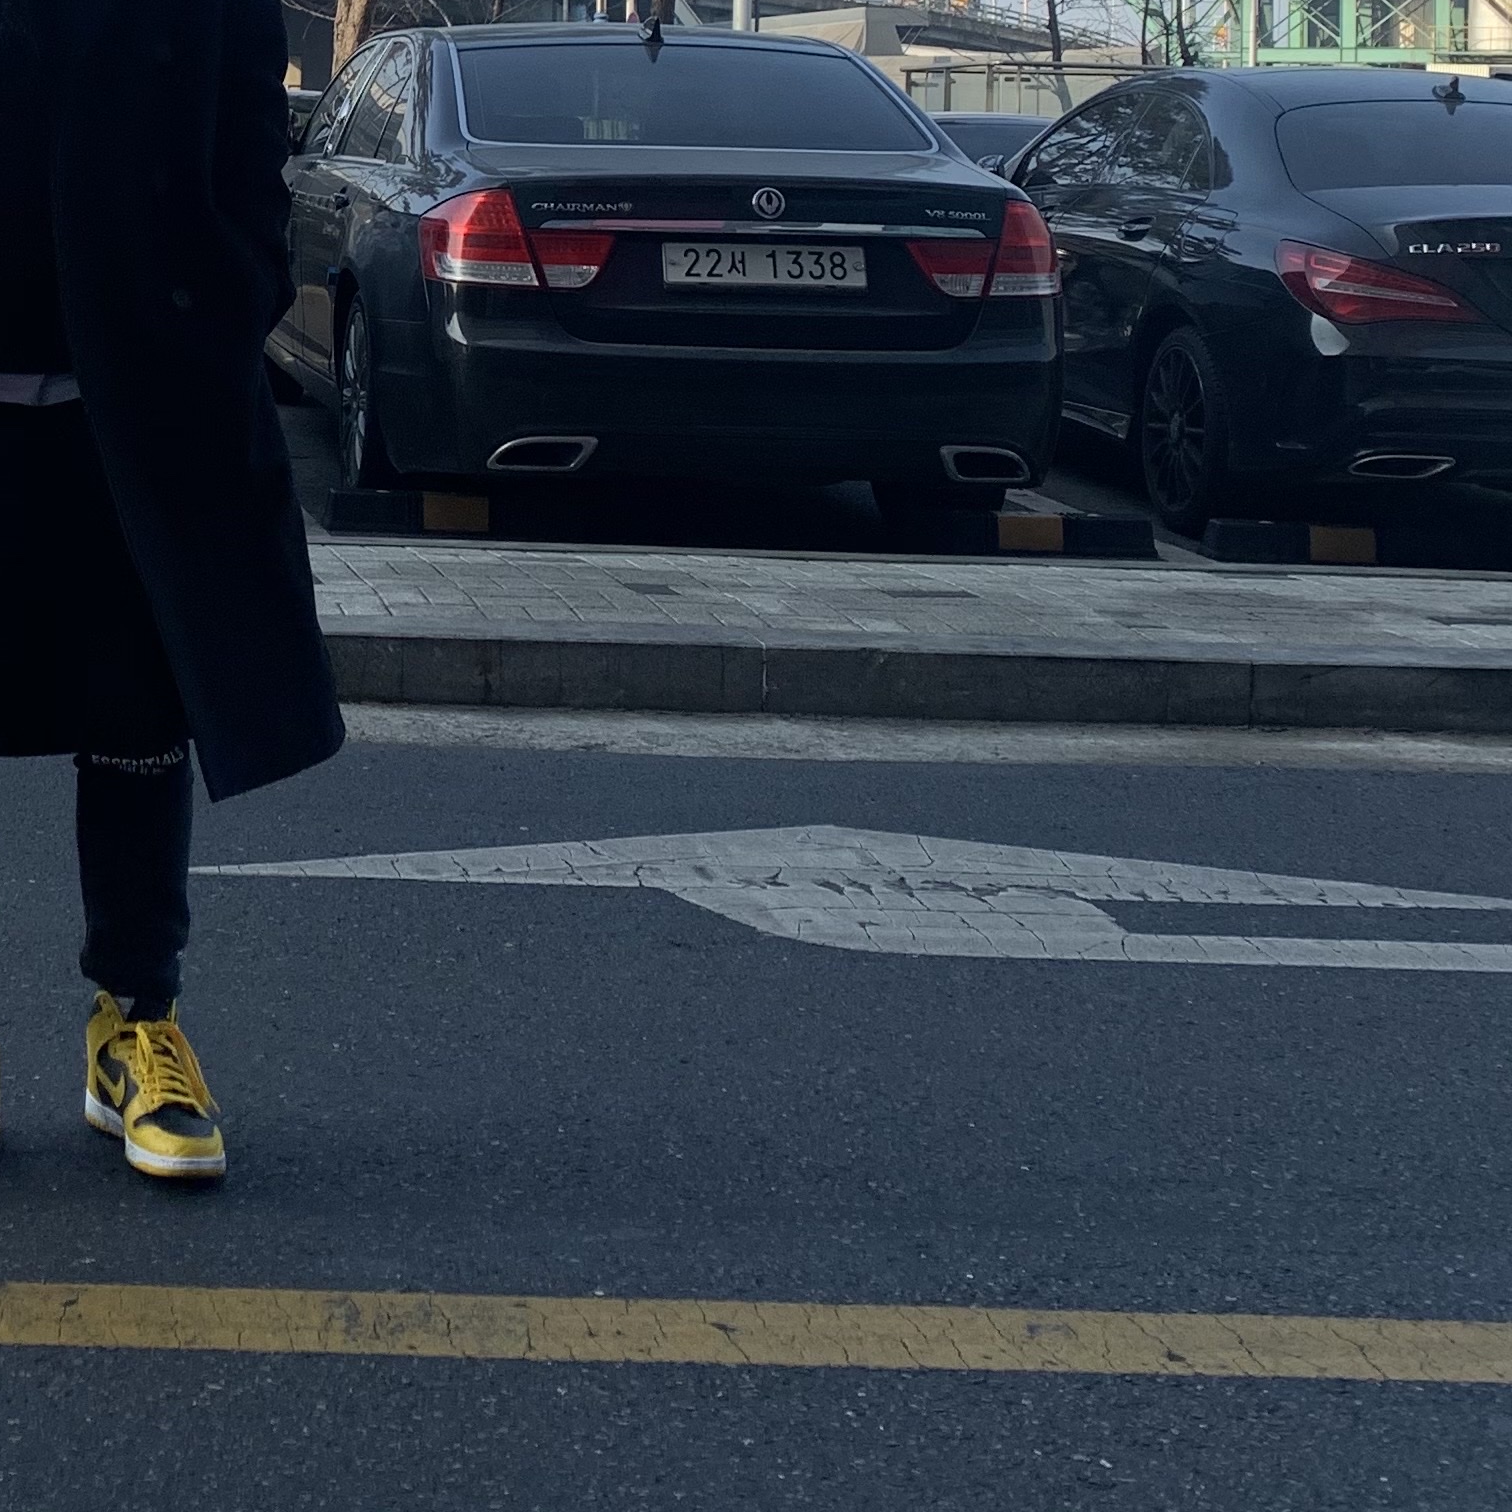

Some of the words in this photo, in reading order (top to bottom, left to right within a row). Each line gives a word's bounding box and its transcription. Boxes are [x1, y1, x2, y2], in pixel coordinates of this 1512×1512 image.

[531, 202, 617, 212] CHAIRMAN
[1408, 243, 1454, 253] CLA
[1457, 242, 1501, 253] 250
[683, 248, 747, 278] 22서
[765, 249, 848, 281] 1338
